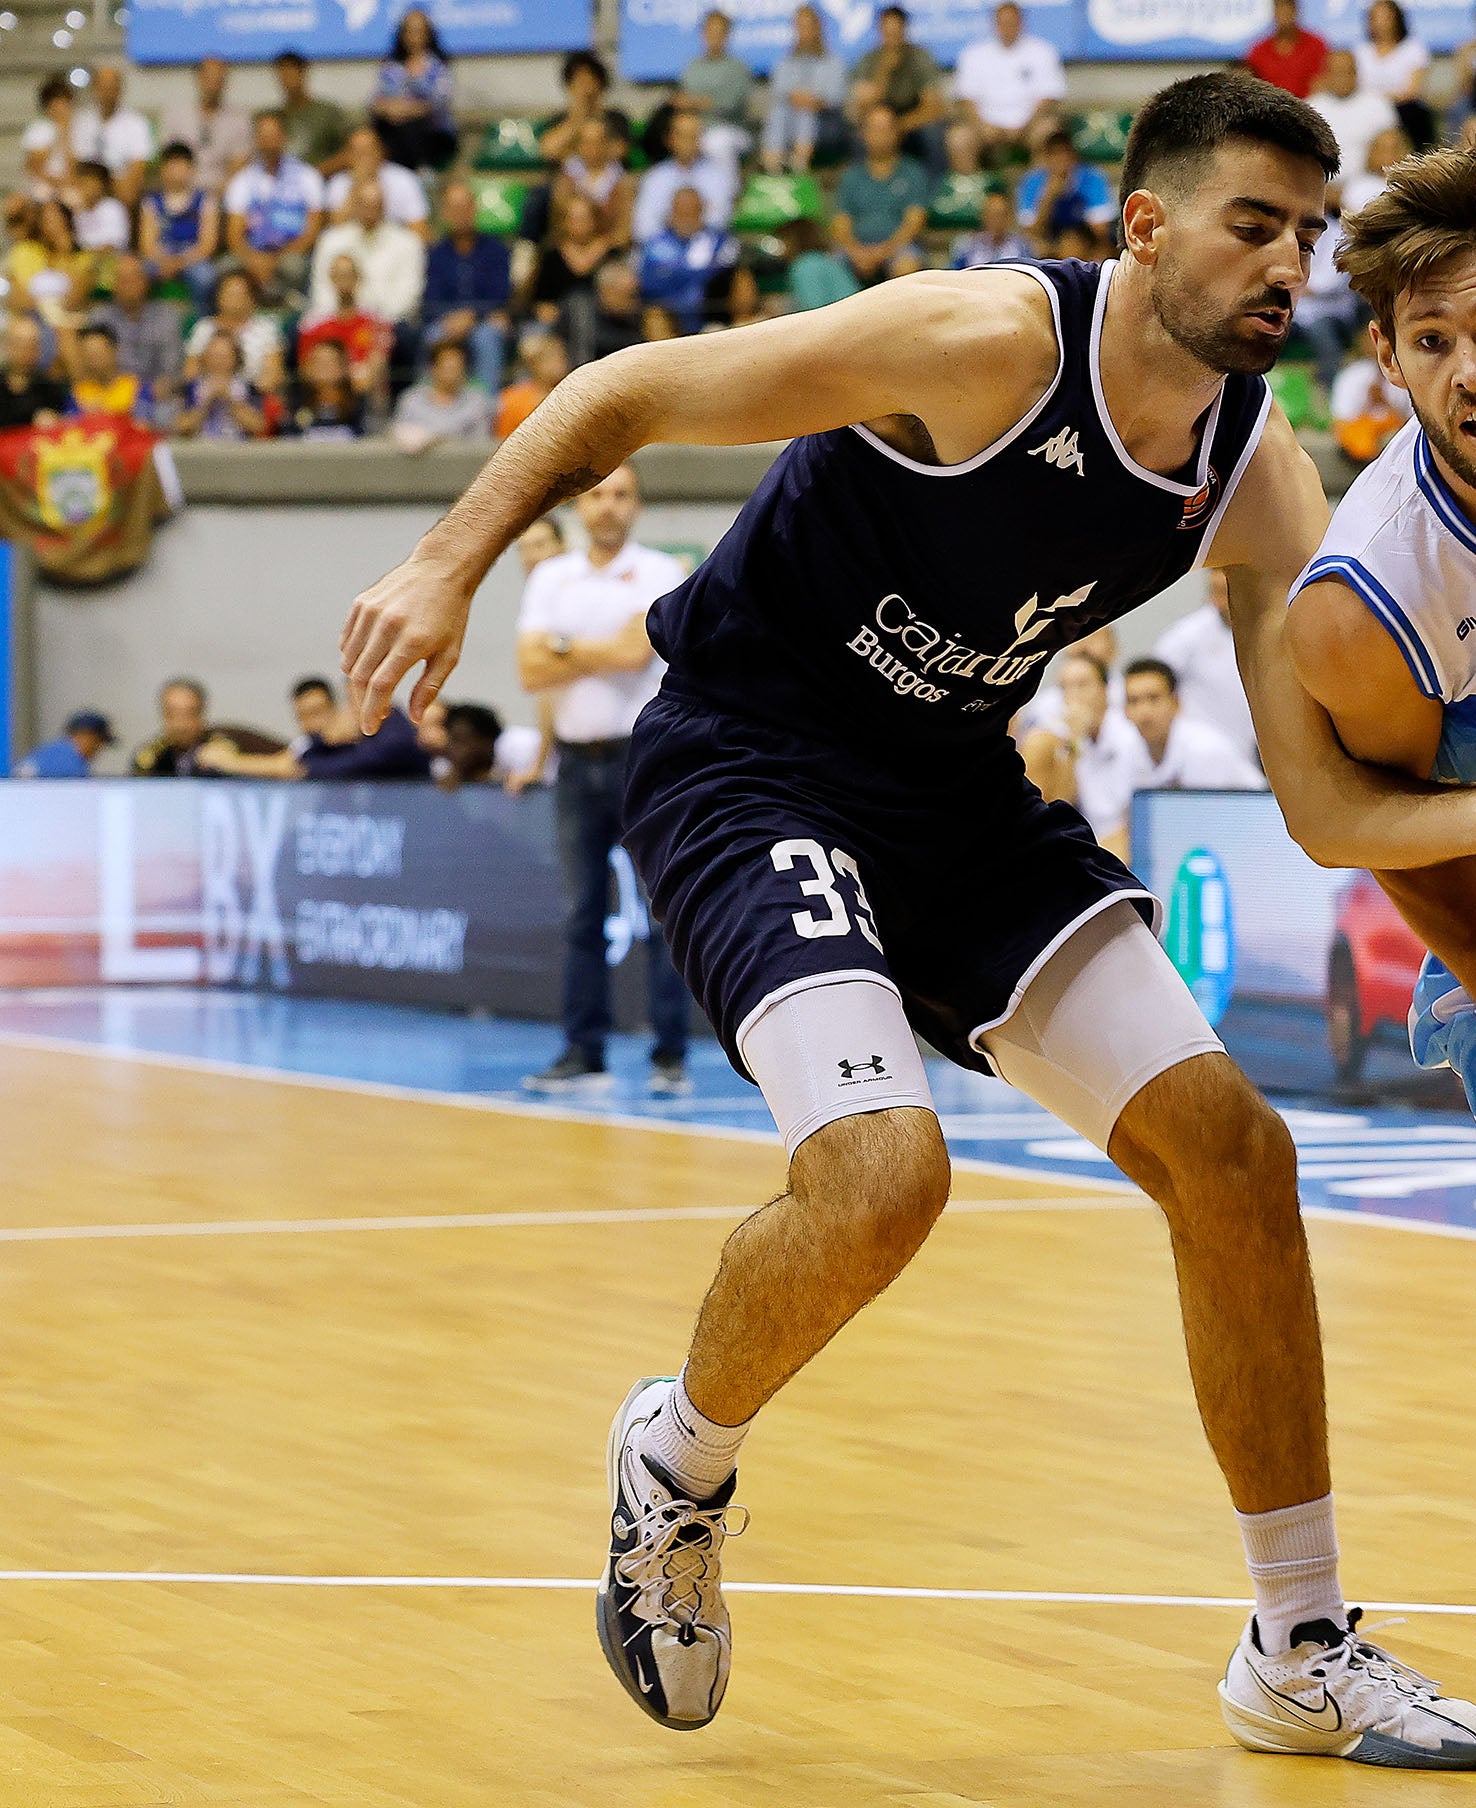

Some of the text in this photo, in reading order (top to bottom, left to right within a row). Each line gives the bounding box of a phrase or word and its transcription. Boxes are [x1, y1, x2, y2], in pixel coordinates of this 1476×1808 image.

[846, 624, 950, 703] Burgos
[769, 839, 884, 955] 33
[863, 1075, 893, 1083] ARMOUR
